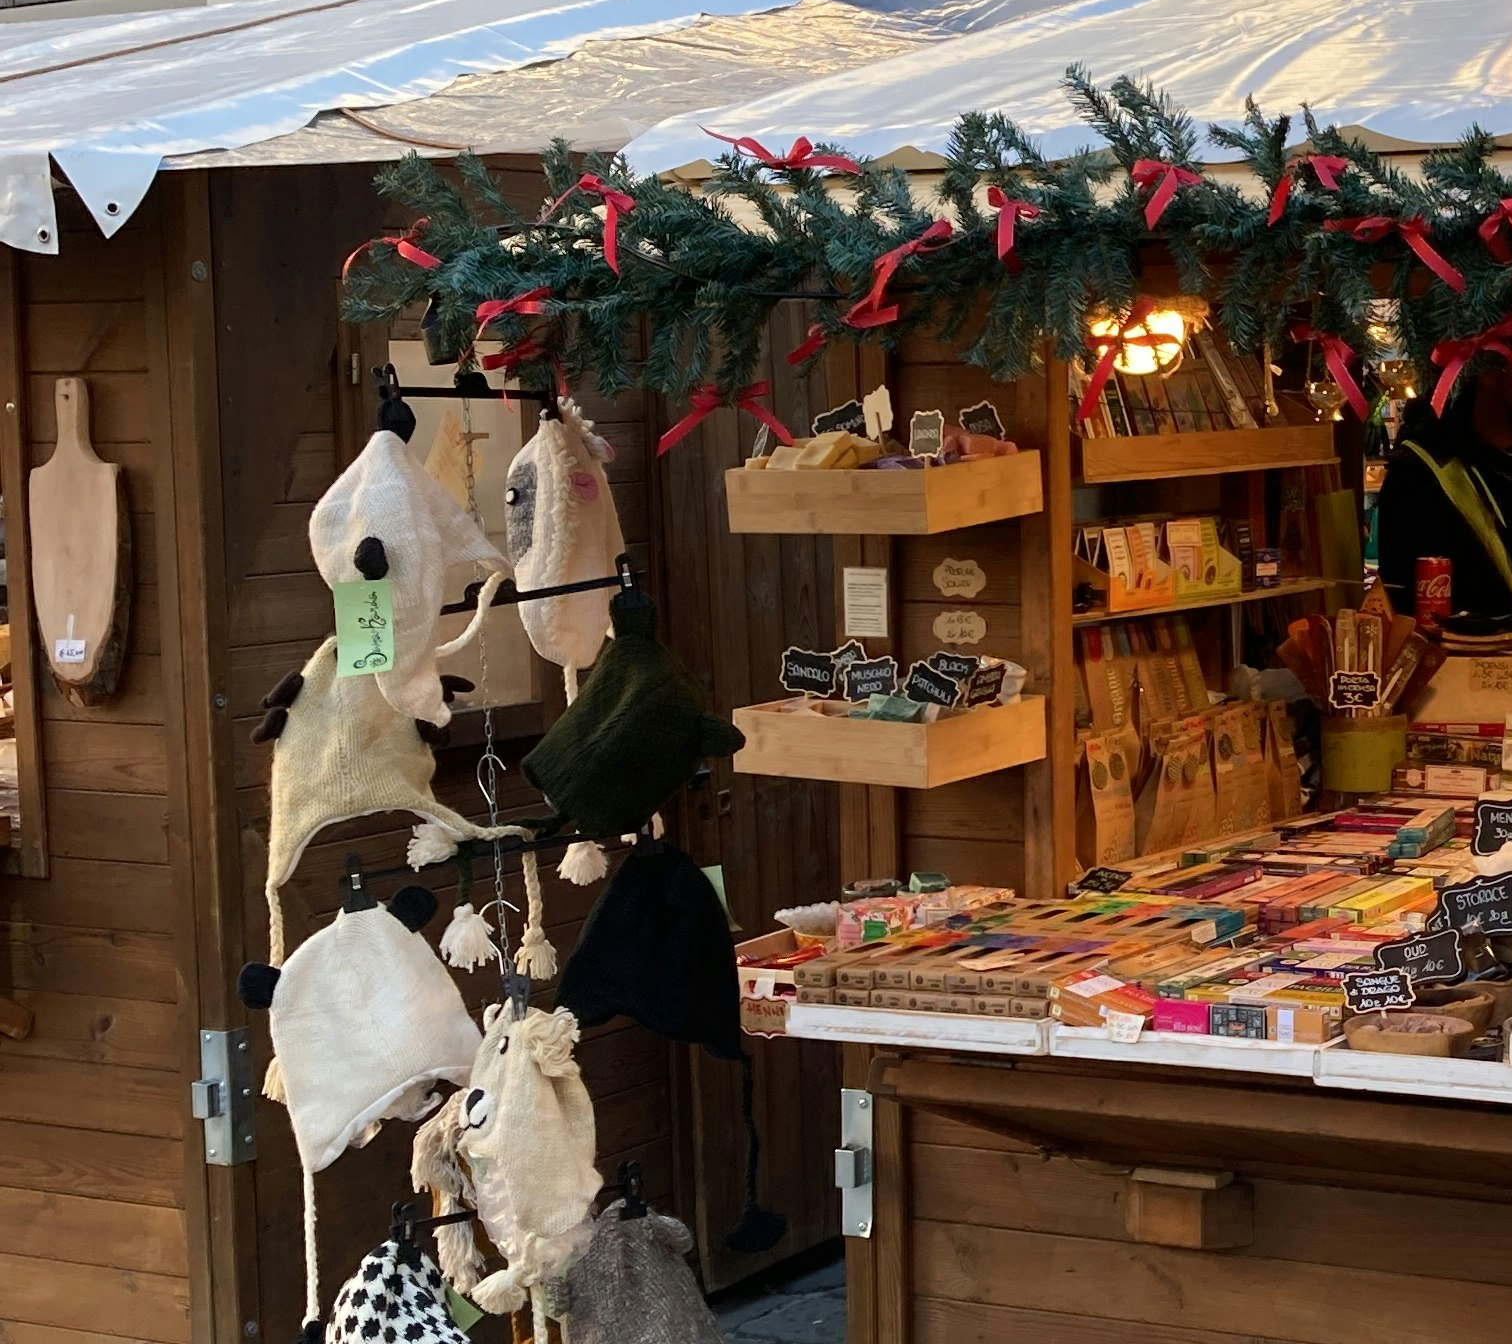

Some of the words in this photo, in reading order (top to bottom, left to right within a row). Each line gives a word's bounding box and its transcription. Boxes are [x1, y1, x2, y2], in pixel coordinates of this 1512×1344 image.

[938, 659, 969, 675] BLACK
[856, 681, 883, 694] NERO
[1342, 693, 1364, 704] 3€
[1455, 885, 1510, 911] STORACE
[1403, 943, 1428, 958] OUD
[1422, 959, 1445, 972] 10€
[1354, 975, 1401, 987] SANGUE
[1361, 985, 1401, 996] DRAGO
[1384, 994, 1406, 1006] 10€
